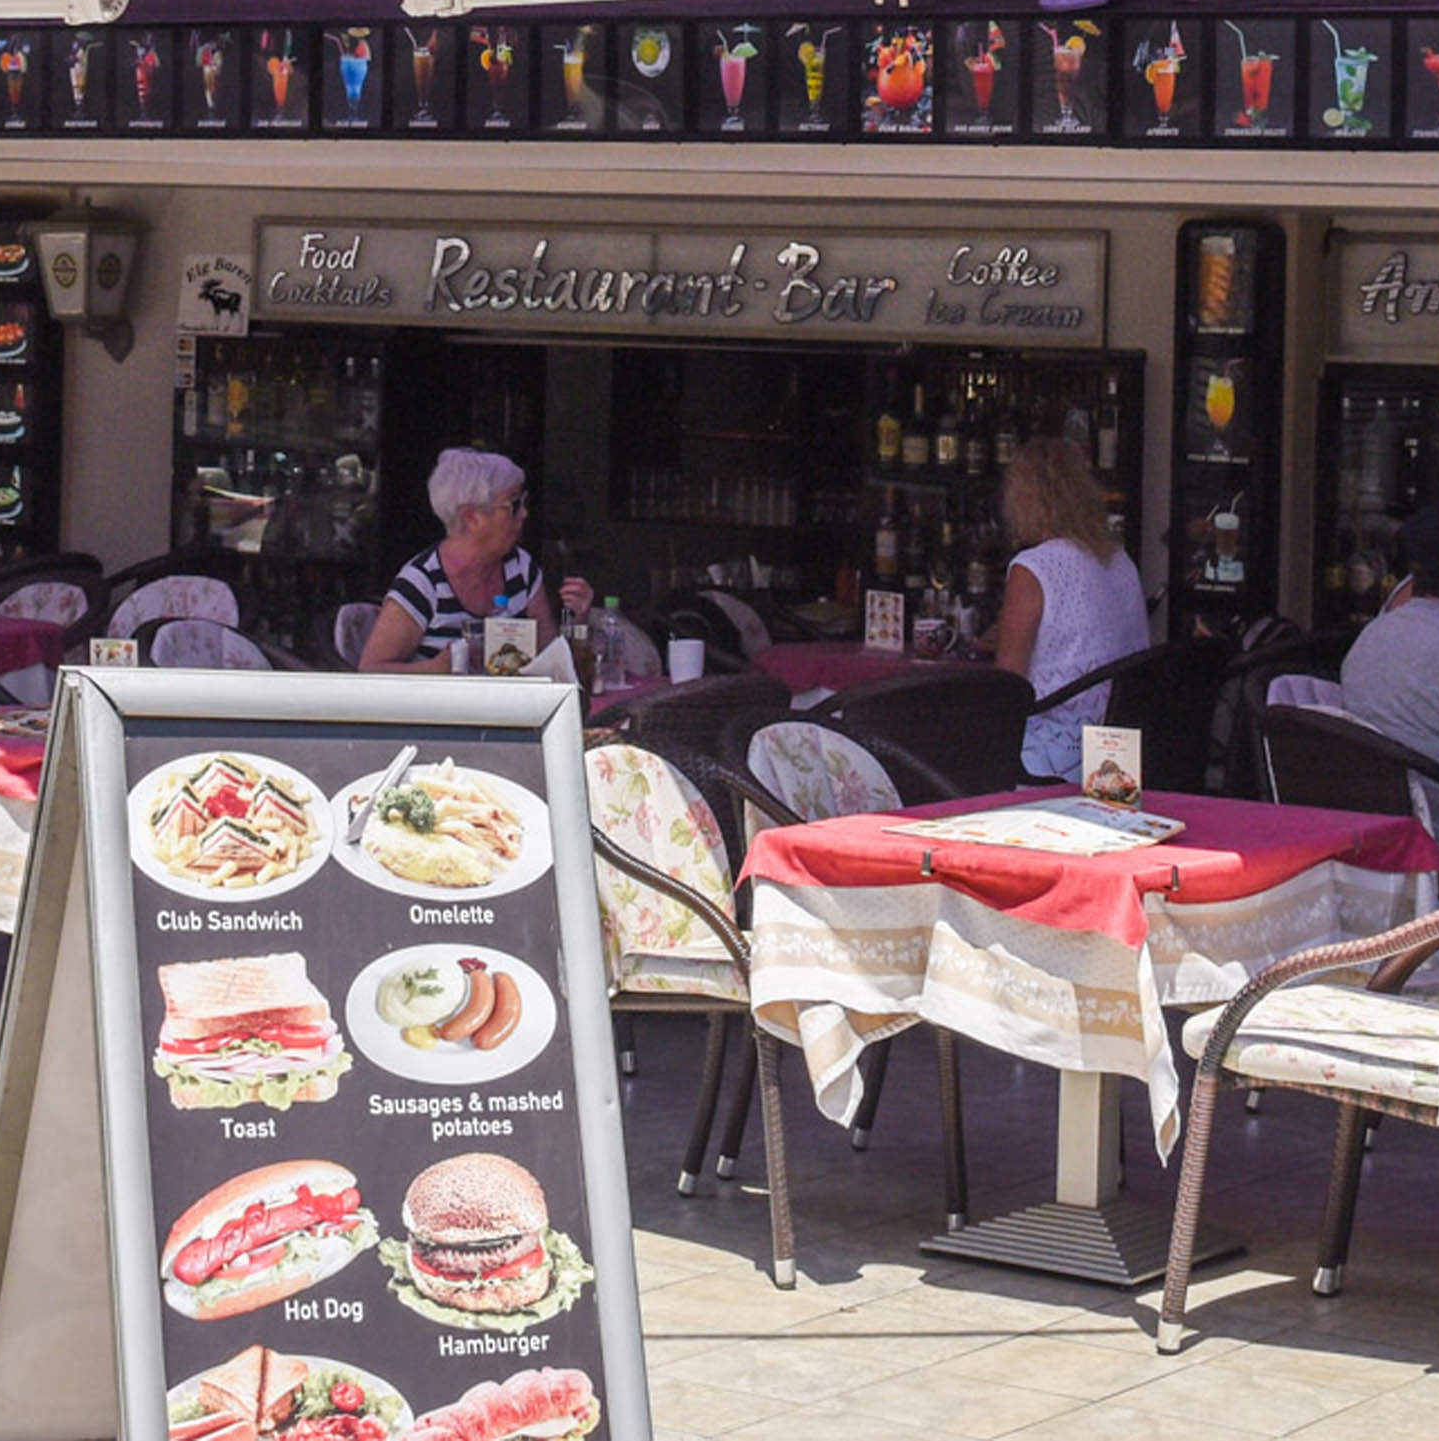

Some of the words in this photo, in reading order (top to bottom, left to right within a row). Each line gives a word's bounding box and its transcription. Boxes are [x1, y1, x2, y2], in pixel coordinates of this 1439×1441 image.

[299, 233, 361, 270] Food
[946, 245, 1060, 287] Coffee
[267, 271, 393, 308] Cocktails
[924, 288, 967, 325] Ice
[978, 288, 1083, 330] Cream
[156, 910, 203, 931] Club
[207, 910, 303, 931] Sandwich
[409, 905, 494, 925] Omelette
[369, 1094, 464, 1118] Sausages
[468, 1092, 484, 1112] &
[488, 1090, 564, 1112] mashed
[219, 1117, 276, 1139] Toast
[431, 1116, 514, 1140] potatoes
[284, 1299, 320, 1322] Hot
[324, 1297, 364, 1323] Dog
[438, 1330, 550, 1357] Hamburger
